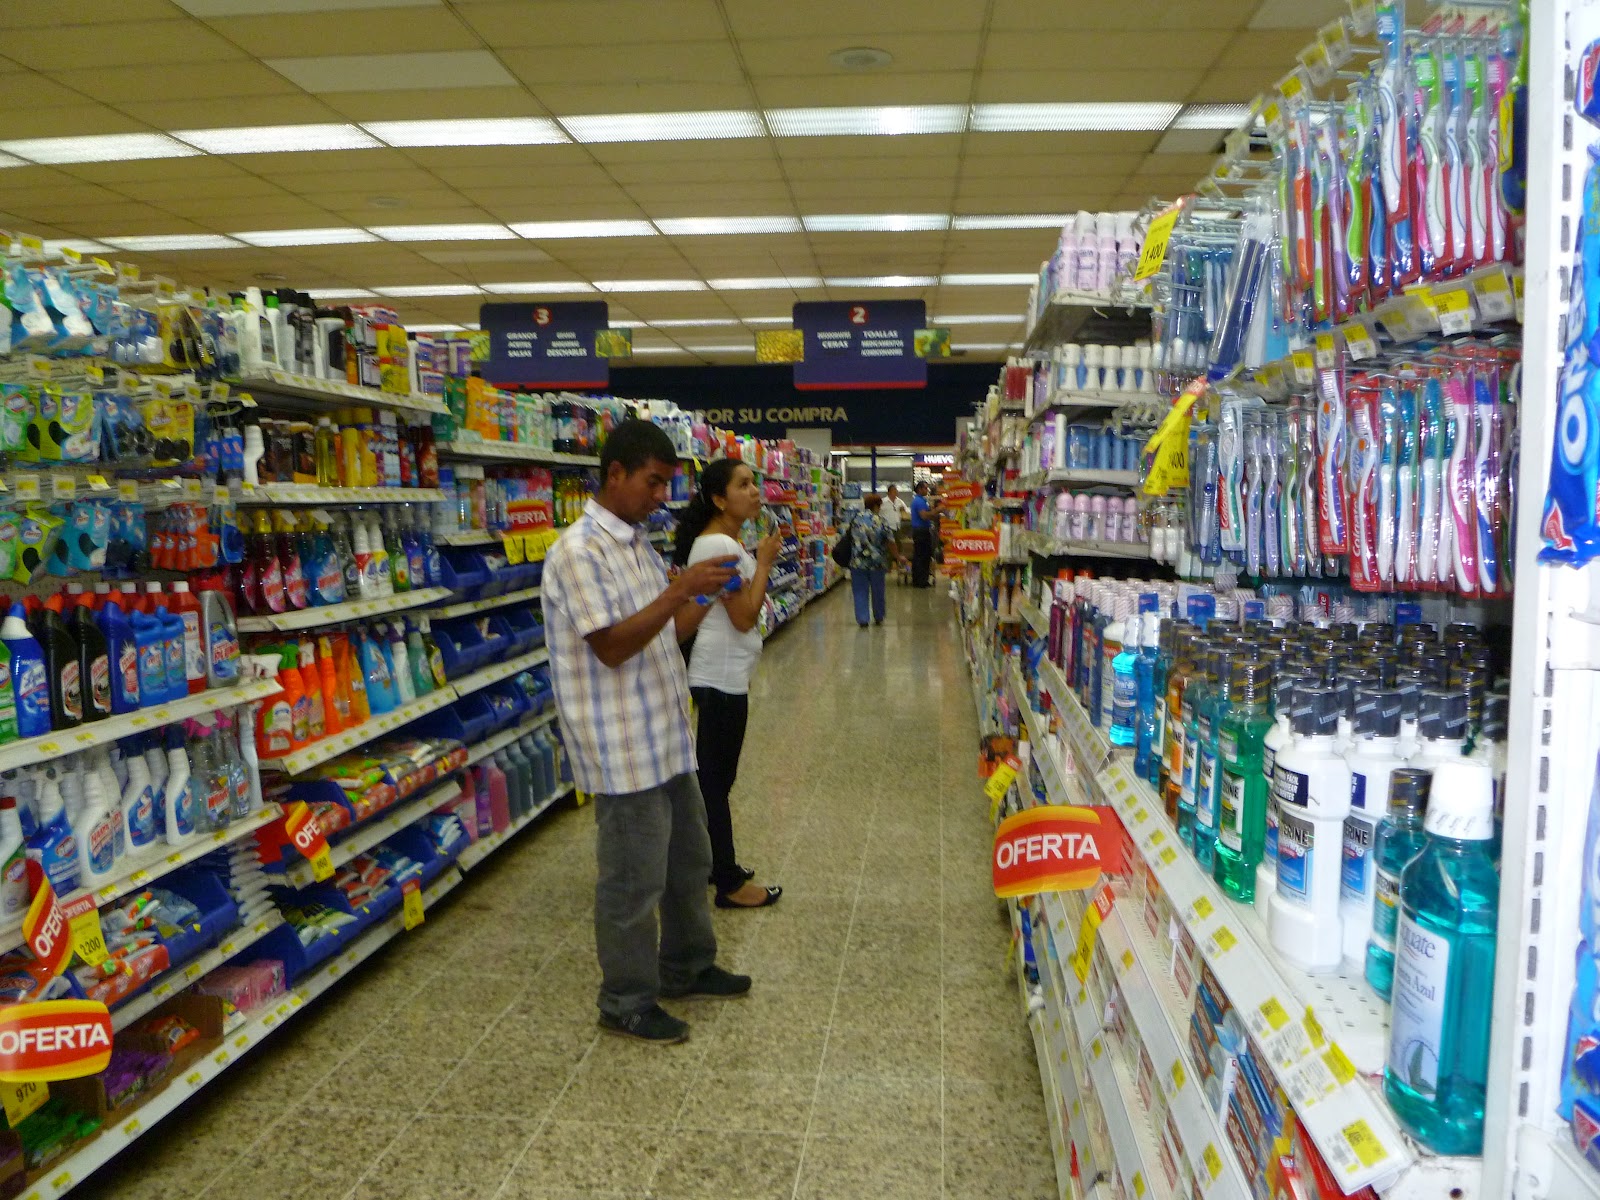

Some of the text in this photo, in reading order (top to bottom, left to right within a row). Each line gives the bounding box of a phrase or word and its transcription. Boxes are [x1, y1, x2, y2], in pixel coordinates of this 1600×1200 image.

[536, 308, 550, 325] 3
[852, 306, 866, 324] 2
[862, 330, 899, 339] TOALLAS
[821, 340, 849, 350] CERAS
[738, 408, 763, 423] SU
[765, 406, 849, 423] COMPRA
[957, 540, 994, 551] OFERTA
[996, 832, 1100, 870] OFERTA
[0, 1022, 111, 1056] OFERTA
